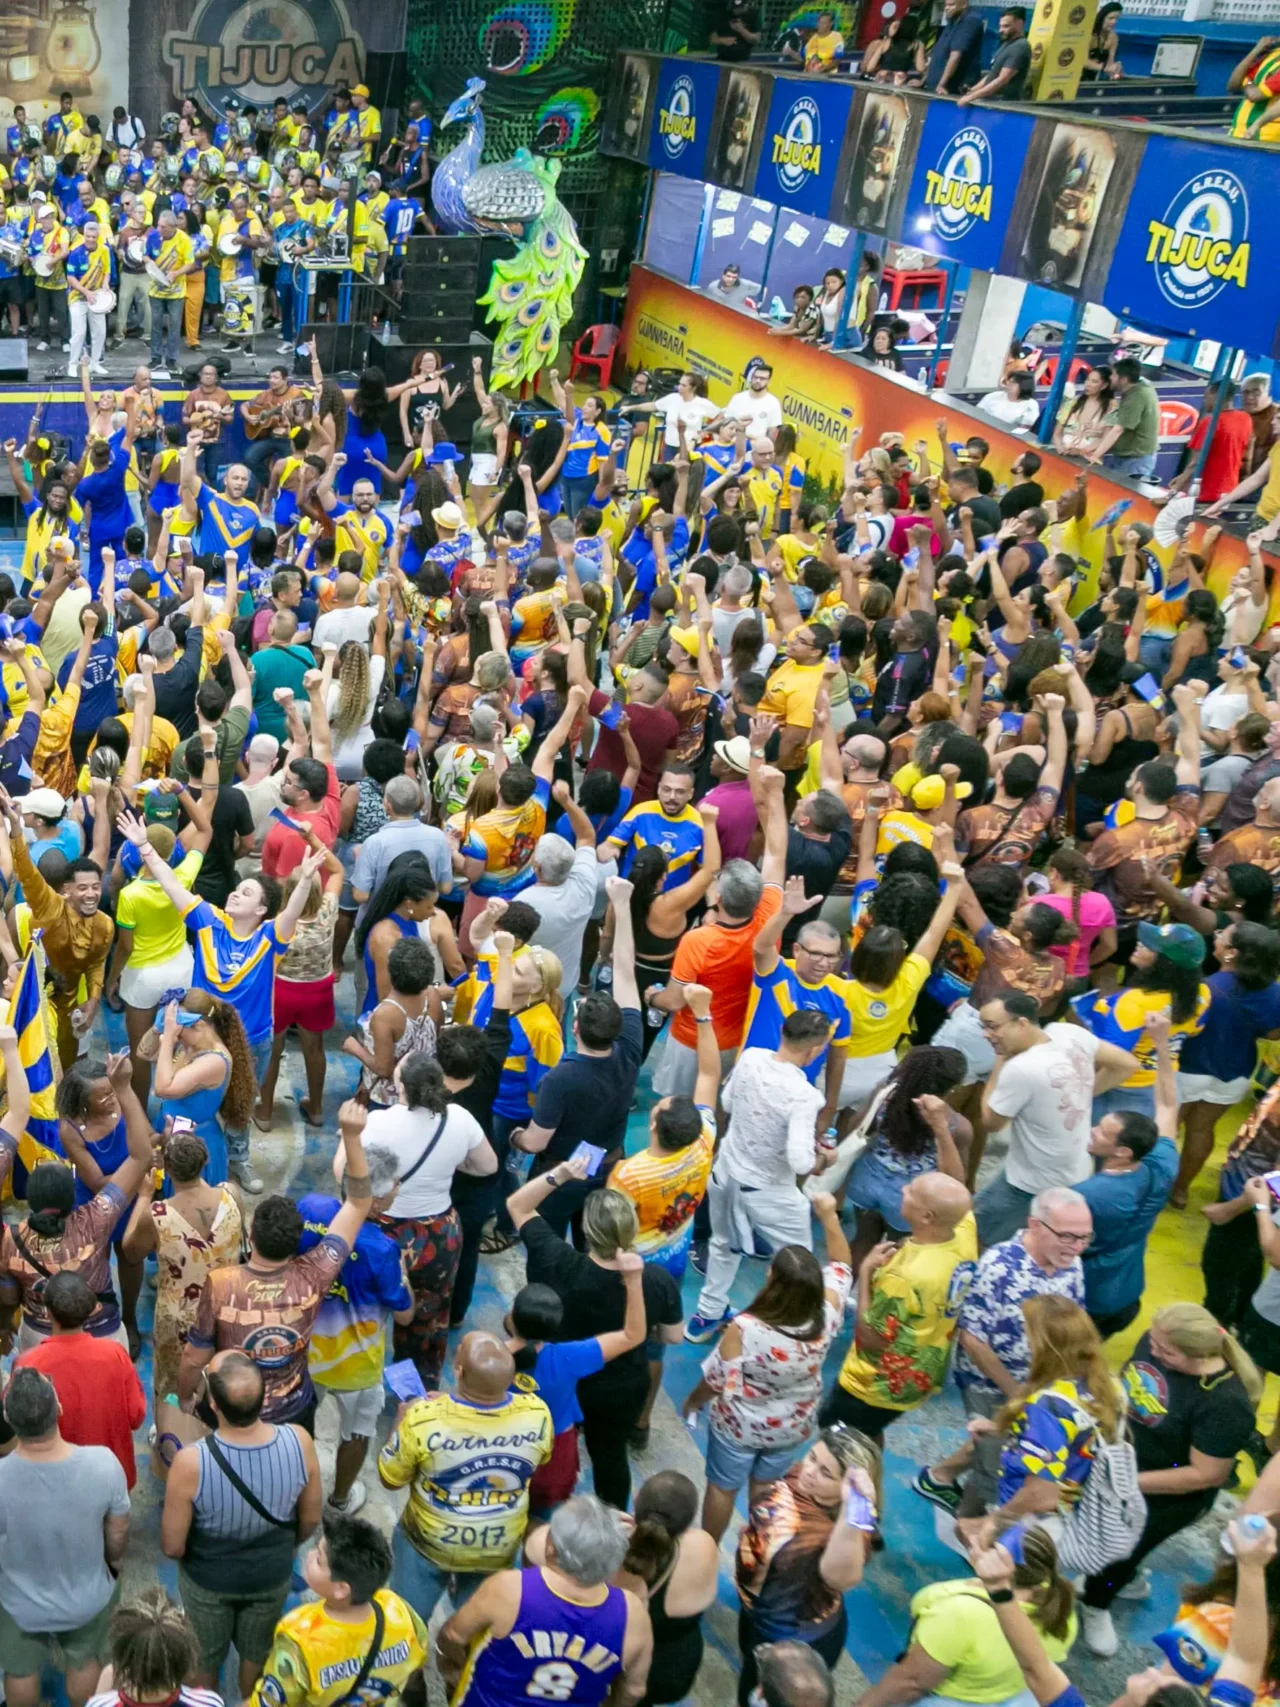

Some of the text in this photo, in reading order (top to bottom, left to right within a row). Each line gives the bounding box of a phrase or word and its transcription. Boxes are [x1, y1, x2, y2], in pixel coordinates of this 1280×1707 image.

[172, 38, 363, 92] TIJUCA
[772, 133, 822, 176] TIJUCA
[924, 169, 994, 222] TIJUCA
[396, 208, 414, 235] 10
[1145, 219, 1252, 289] TIJUCA
[637, 317, 685, 358] GUANABARA
[781, 394, 850, 444] GUANABARA
[426, 1416, 547, 1452] Carnaval
